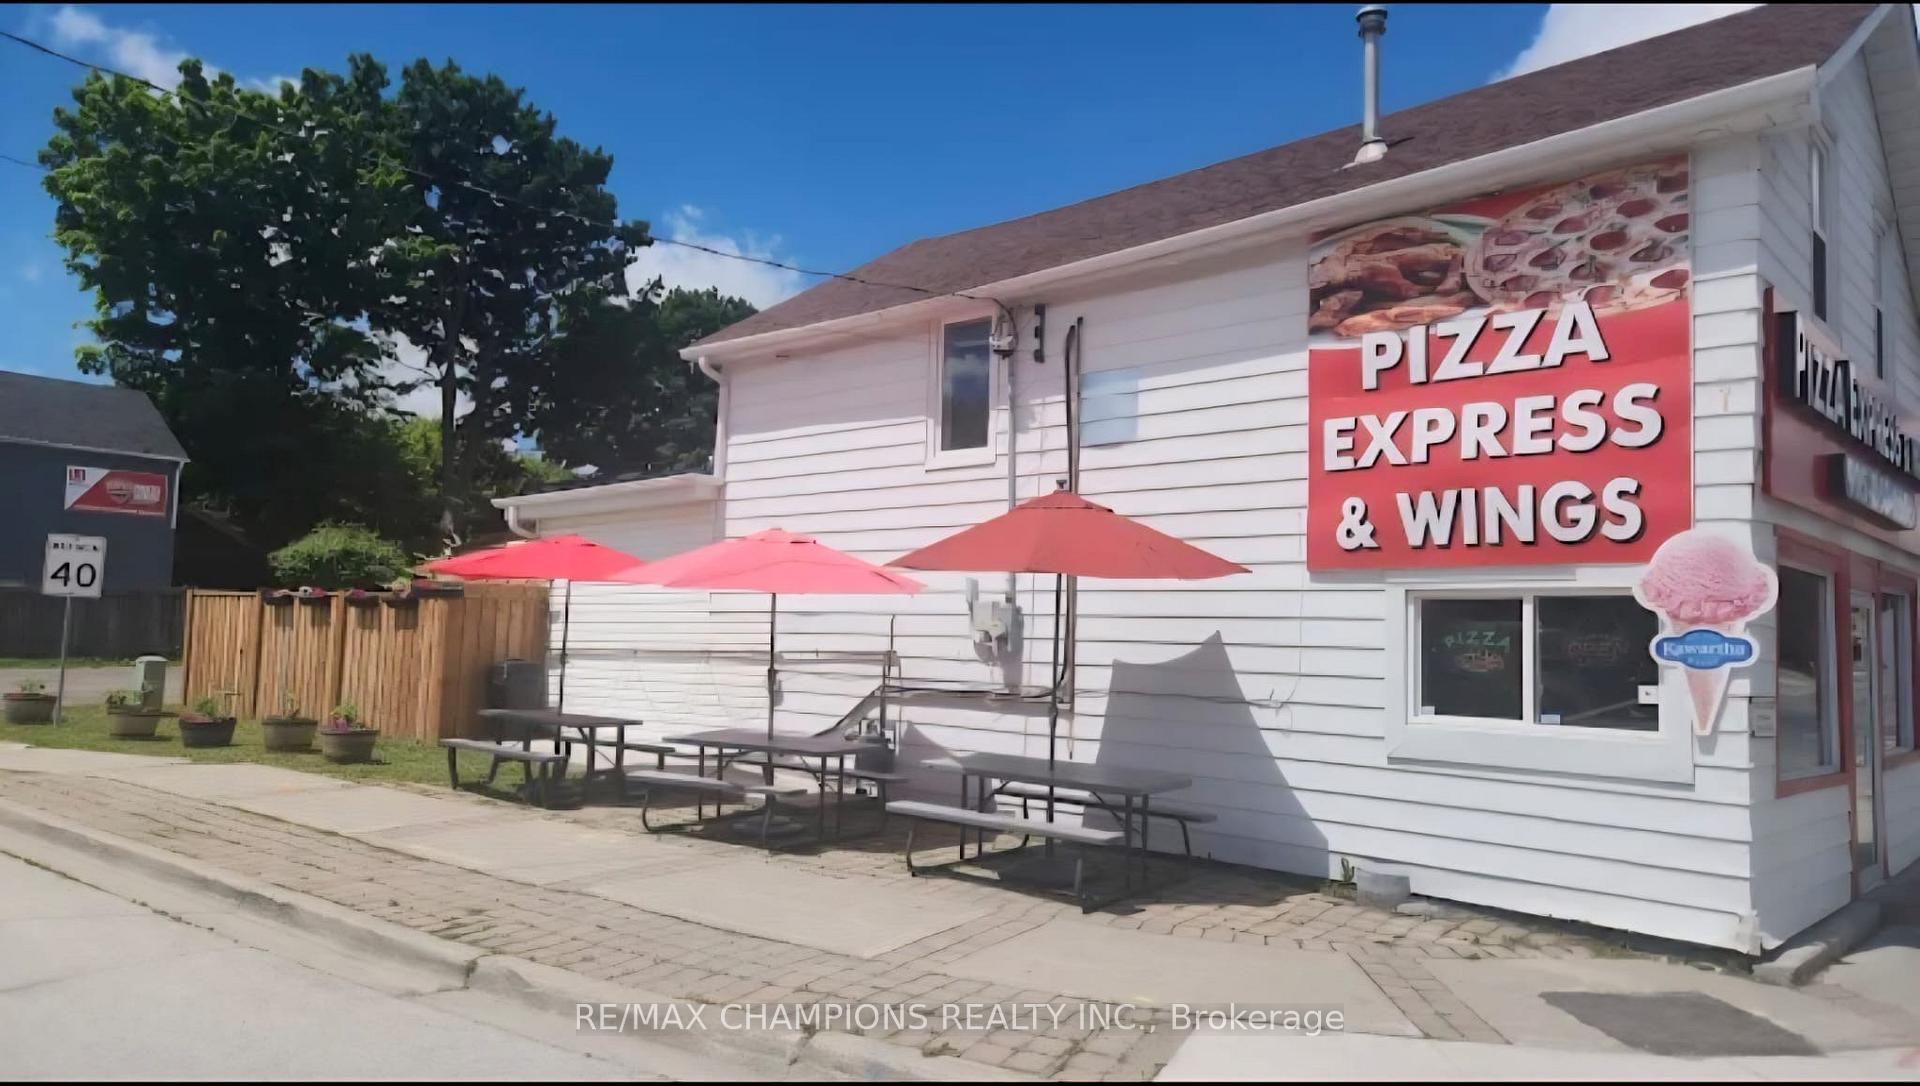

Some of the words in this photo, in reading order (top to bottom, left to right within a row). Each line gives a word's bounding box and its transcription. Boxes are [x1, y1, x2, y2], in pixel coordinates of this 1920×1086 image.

[1363, 301, 1608, 390] PIZZA
[1795, 310, 1848, 429] PIZZA
[1324, 383, 1663, 471] EXPRESS
[1336, 497, 1379, 550] &
[1396, 477, 1643, 547] WINGS
[50, 562, 97, 588] 40
[1663, 642, 1746, 656] Kawartha
